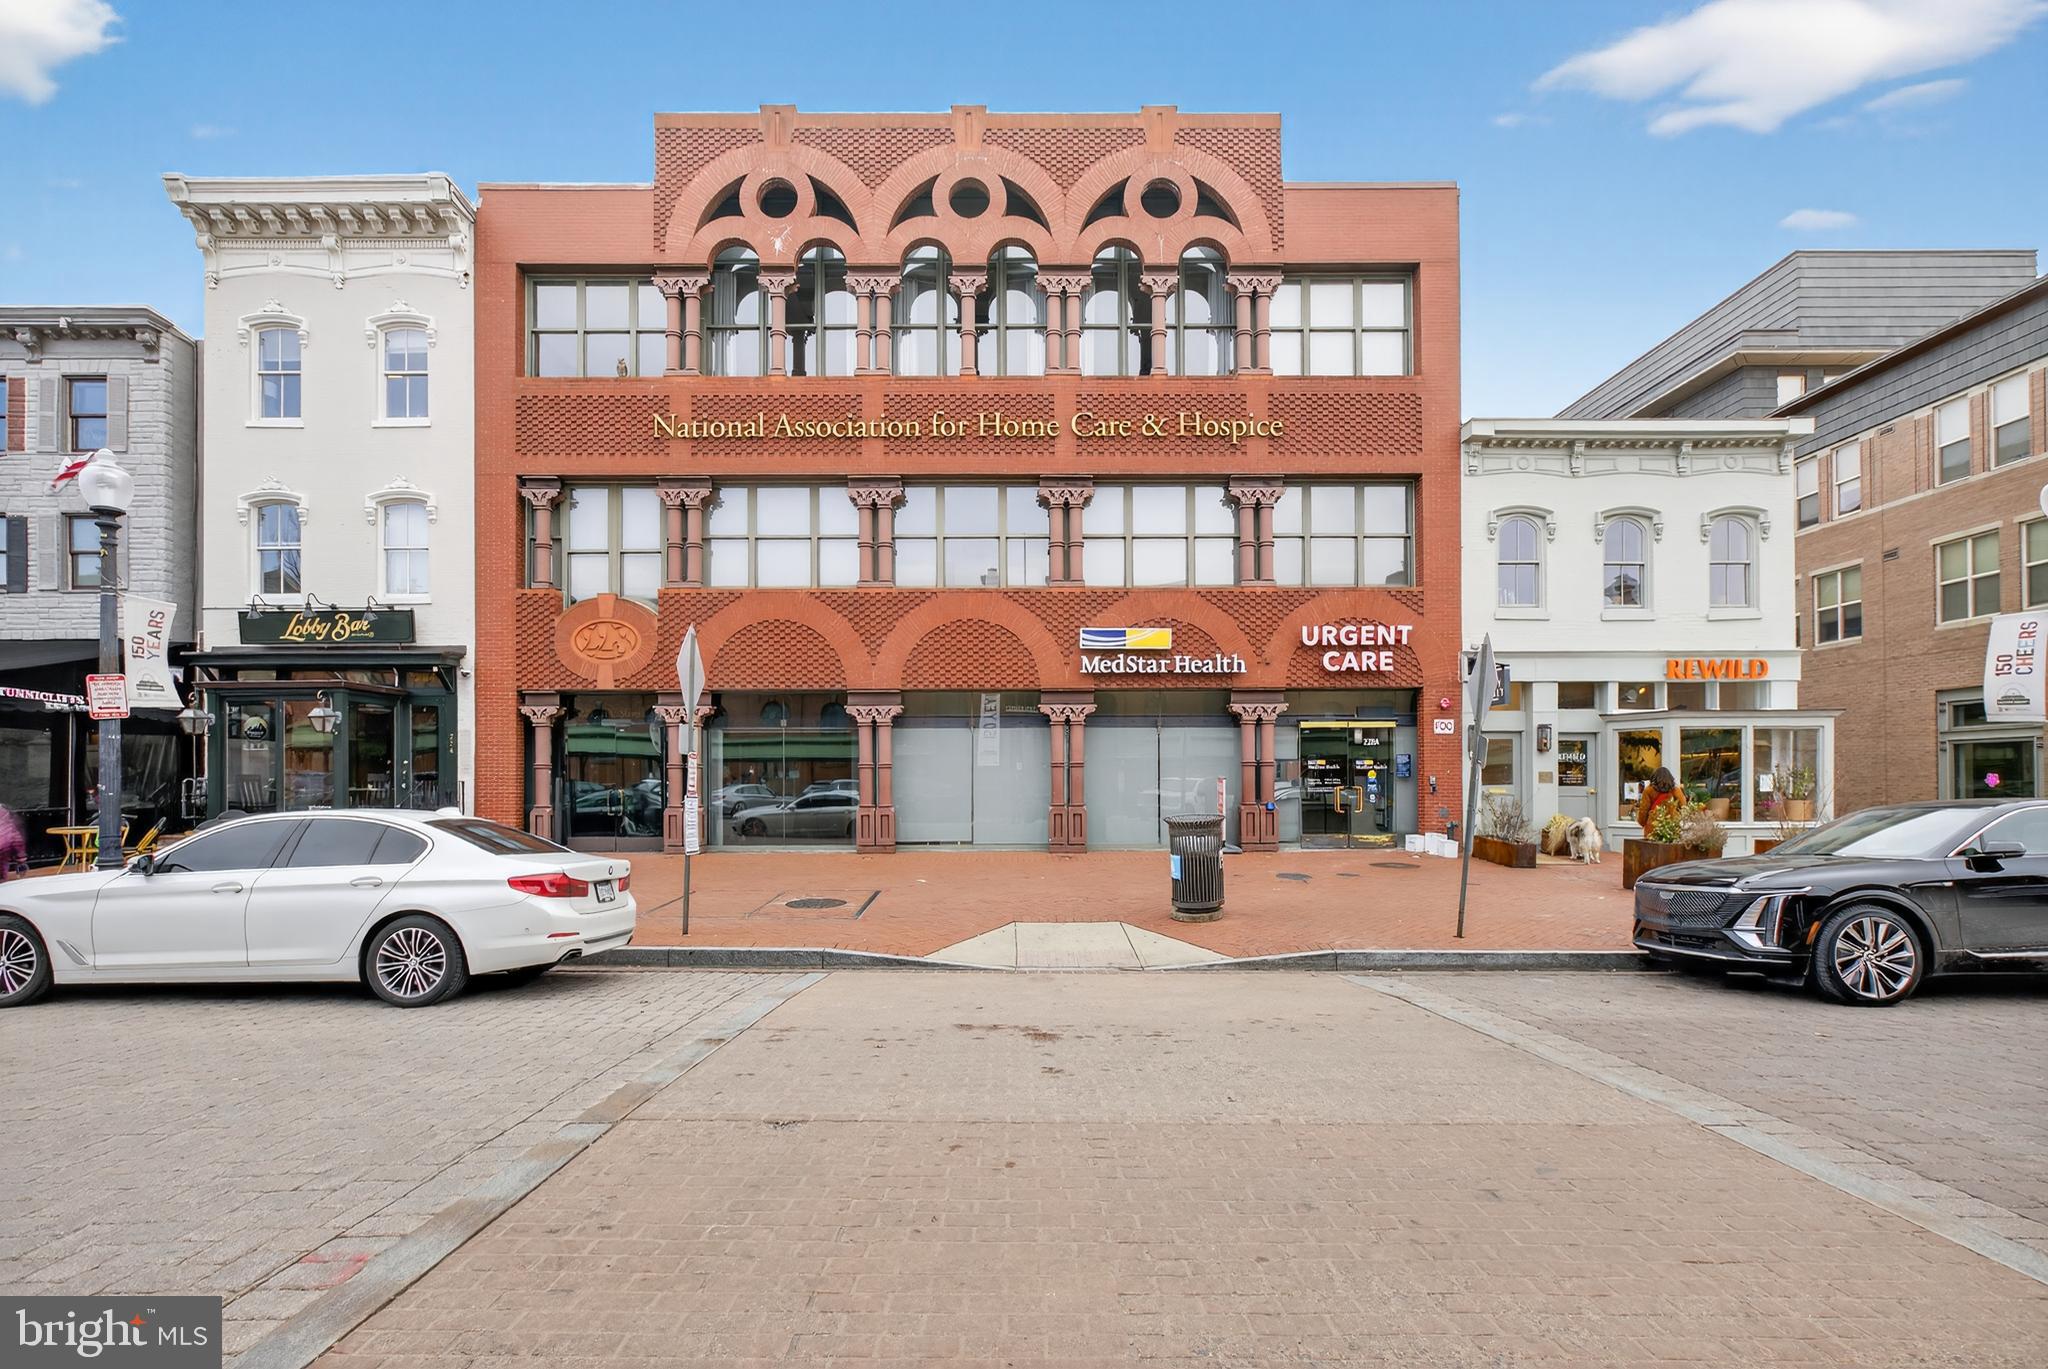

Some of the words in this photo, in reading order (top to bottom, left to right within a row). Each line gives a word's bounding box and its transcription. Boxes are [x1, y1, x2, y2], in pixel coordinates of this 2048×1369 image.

[653, 412, 764, 438] National
[774, 413, 921, 437] Association
[932, 411, 969, 437] for
[977, 412, 1060, 437] Home
[1071, 412, 1132, 437] Care
[1141, 413, 1169, 437] &
[1176, 411, 1284, 445] Hospice
[146, 610, 165, 660] YEARS
[279, 613, 331, 641] Lobby
[331, 613, 370, 642] Bar
[1302, 625, 1412, 646] URGENT
[131, 636, 145, 659] 150
[2015, 621, 2038, 675] CHEERS
[1080, 655, 1171, 674] MedStar
[1174, 654, 1247, 674] Health
[1322, 651, 1394, 672] CARE
[1665, 658, 1769, 680] REWILD
[1995, 654, 2014, 676] 150
